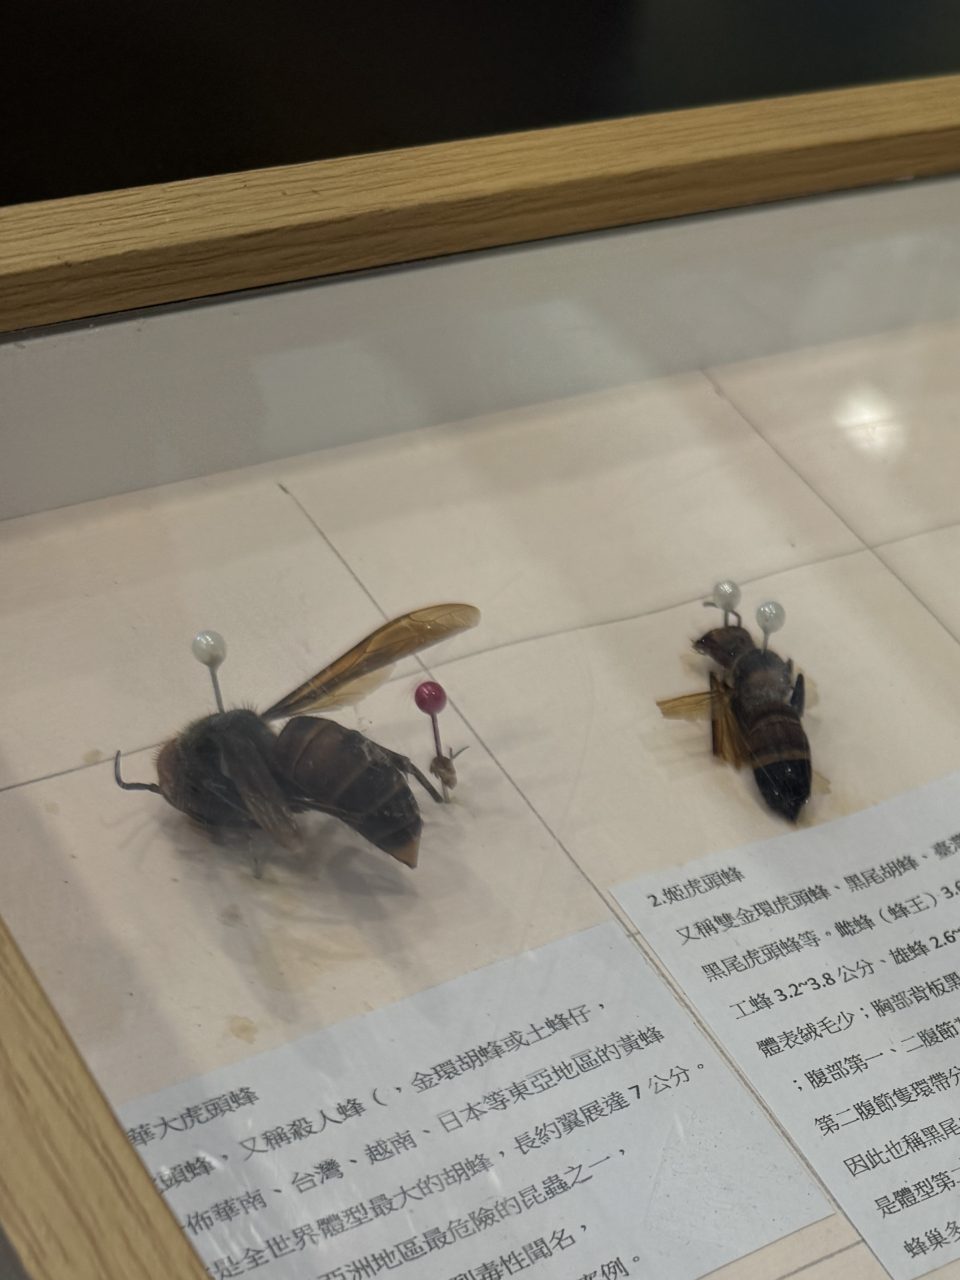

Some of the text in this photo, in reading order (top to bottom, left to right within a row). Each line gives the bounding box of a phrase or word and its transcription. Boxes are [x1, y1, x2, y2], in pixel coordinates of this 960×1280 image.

[647, 866, 745, 908] 2.姬虎頭蜂
[773, 972, 837, 1002] 3.2~3.8
[144, 1003, 605, 1201] 頭蜂，又稱殺人蜂（，金環胡蜂或土蜂仔，
[627, 1084, 641, 1100] 7
[171, 1026, 665, 1245] 佈華南、台灣、越南、日本等東亞地區的黃蜂
